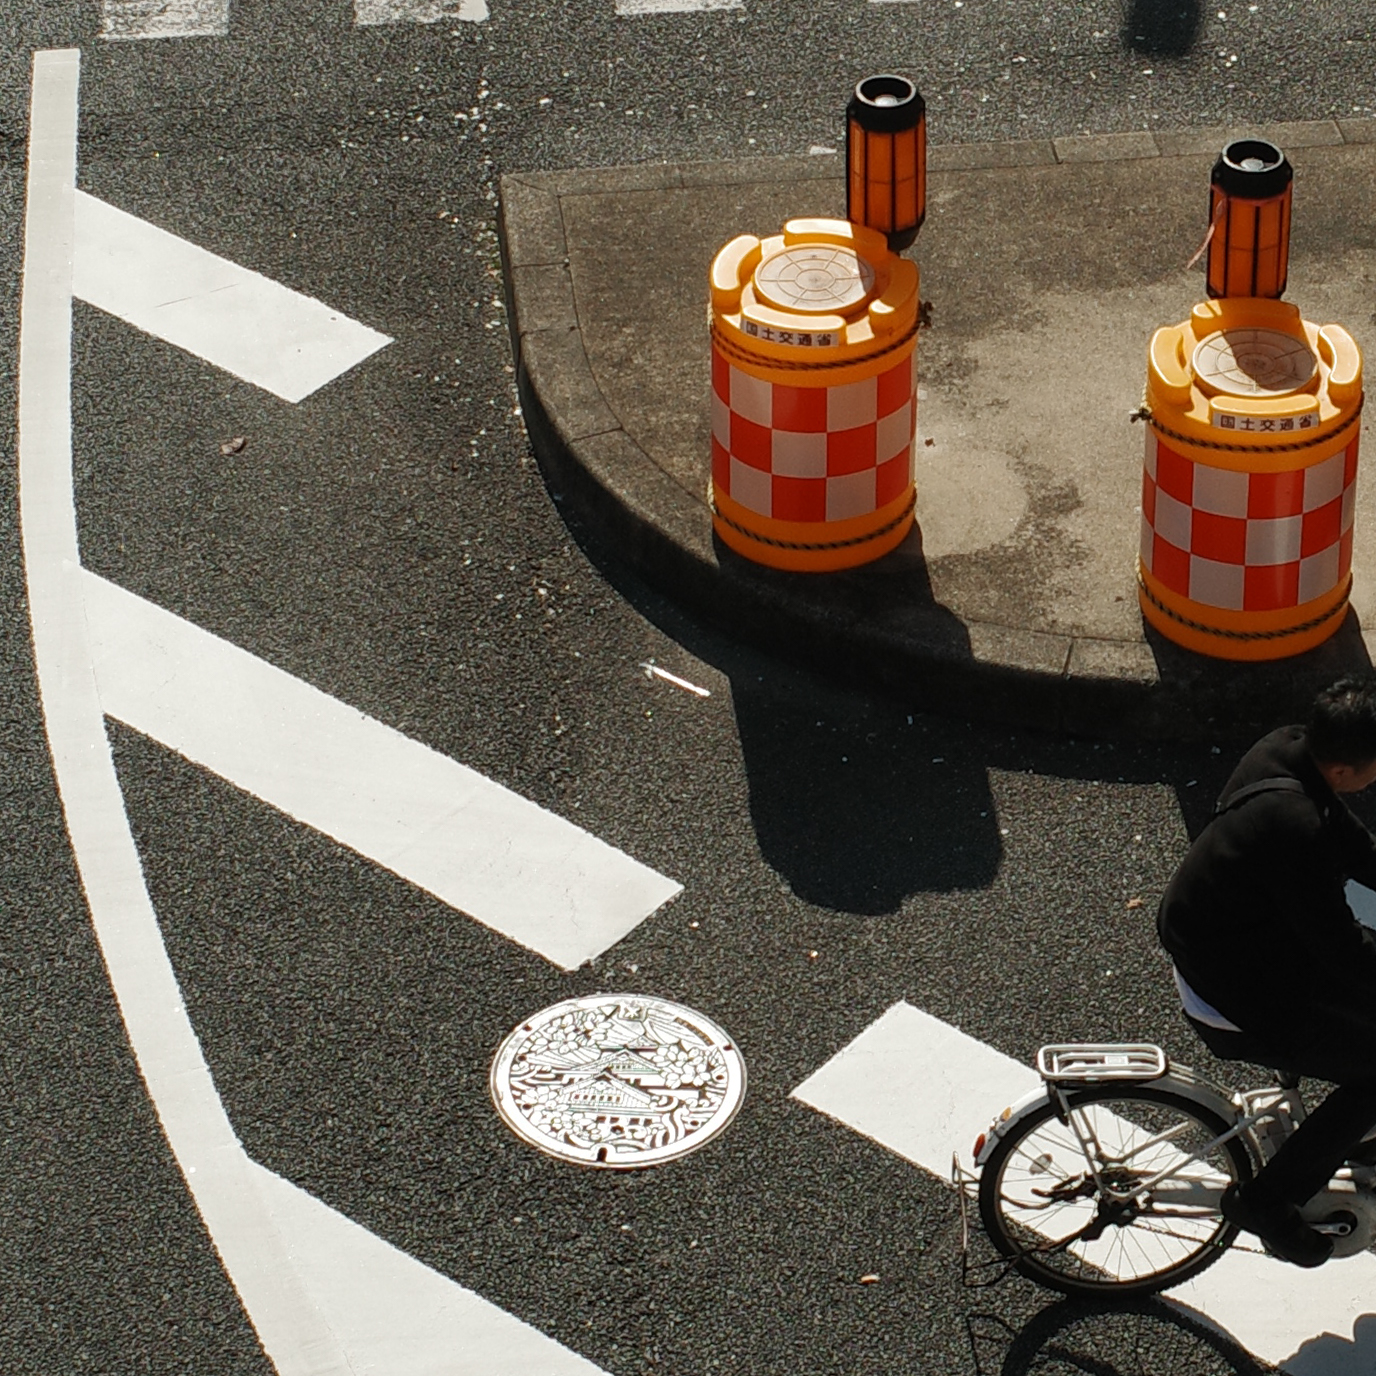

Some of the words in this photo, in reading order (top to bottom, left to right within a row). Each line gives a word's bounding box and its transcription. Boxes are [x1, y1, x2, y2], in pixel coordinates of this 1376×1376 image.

[745, 320, 832, 347] 国土交通省
[1220, 413, 1312, 432] 国土交通省
